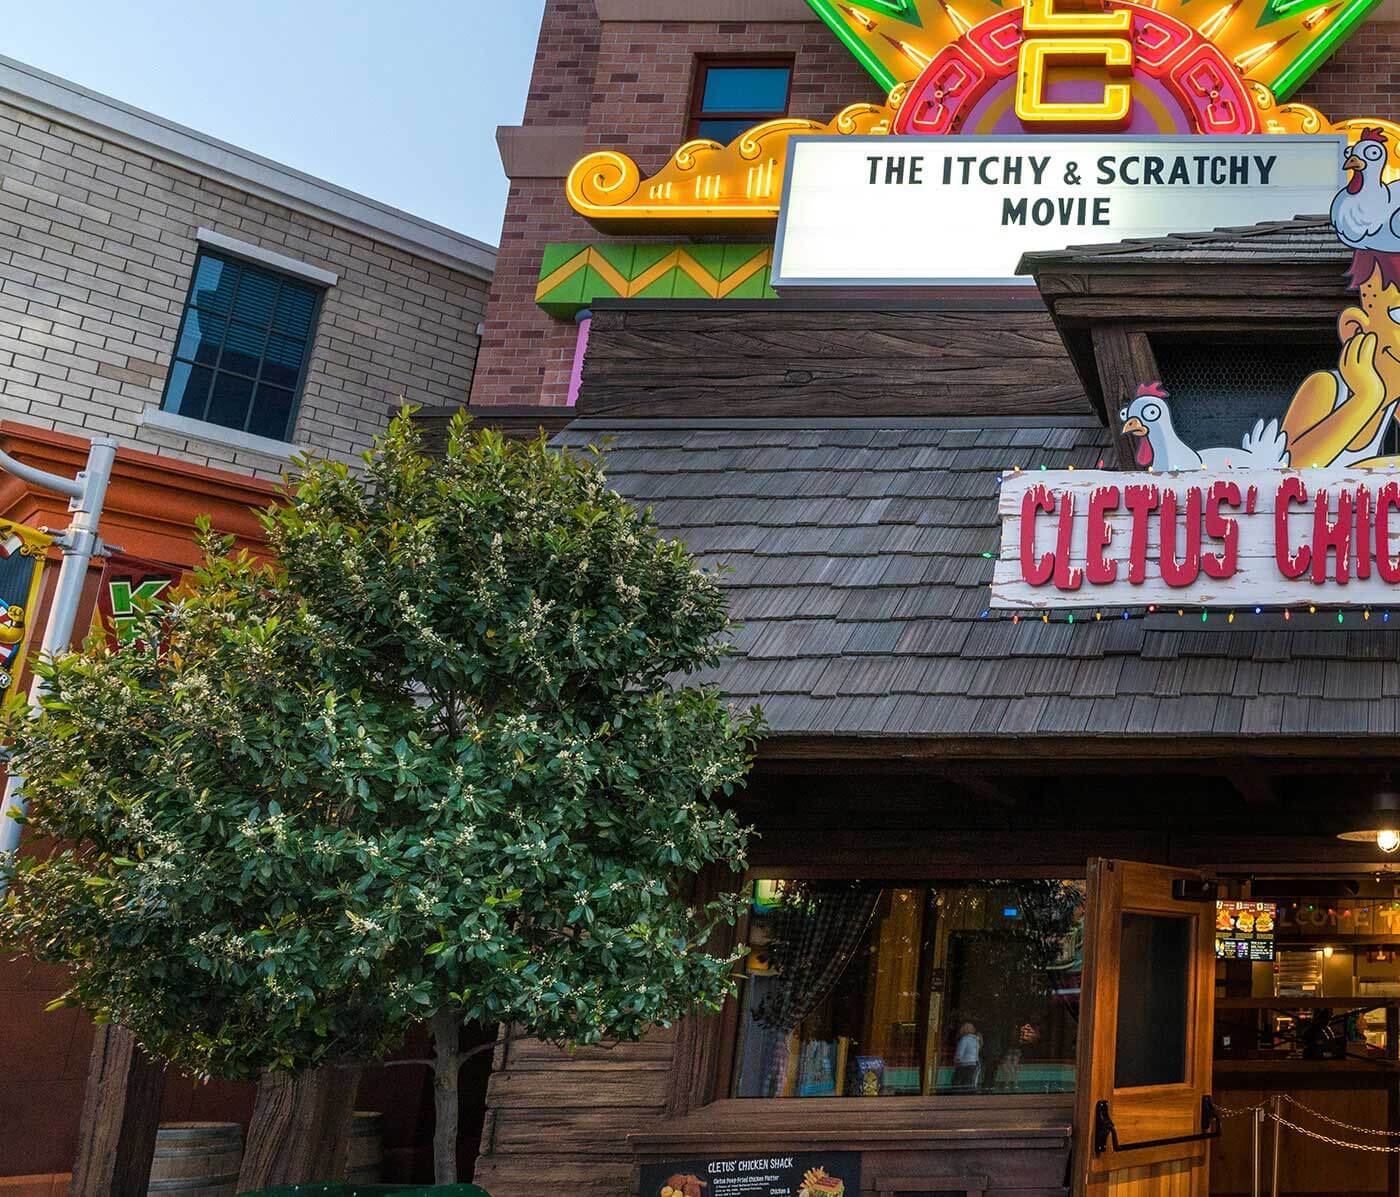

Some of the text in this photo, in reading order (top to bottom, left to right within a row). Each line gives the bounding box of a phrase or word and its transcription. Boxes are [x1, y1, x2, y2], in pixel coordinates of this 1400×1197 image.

[867, 156, 1277, 185] THE ITCHY & SCRATCHY
[1001, 197, 1111, 226] MOVIE
[1019, 481, 1258, 590] CLETUS'
[738, 1159, 769, 1172] CHICKEN
[770, 1157, 794, 1169] SHACK
